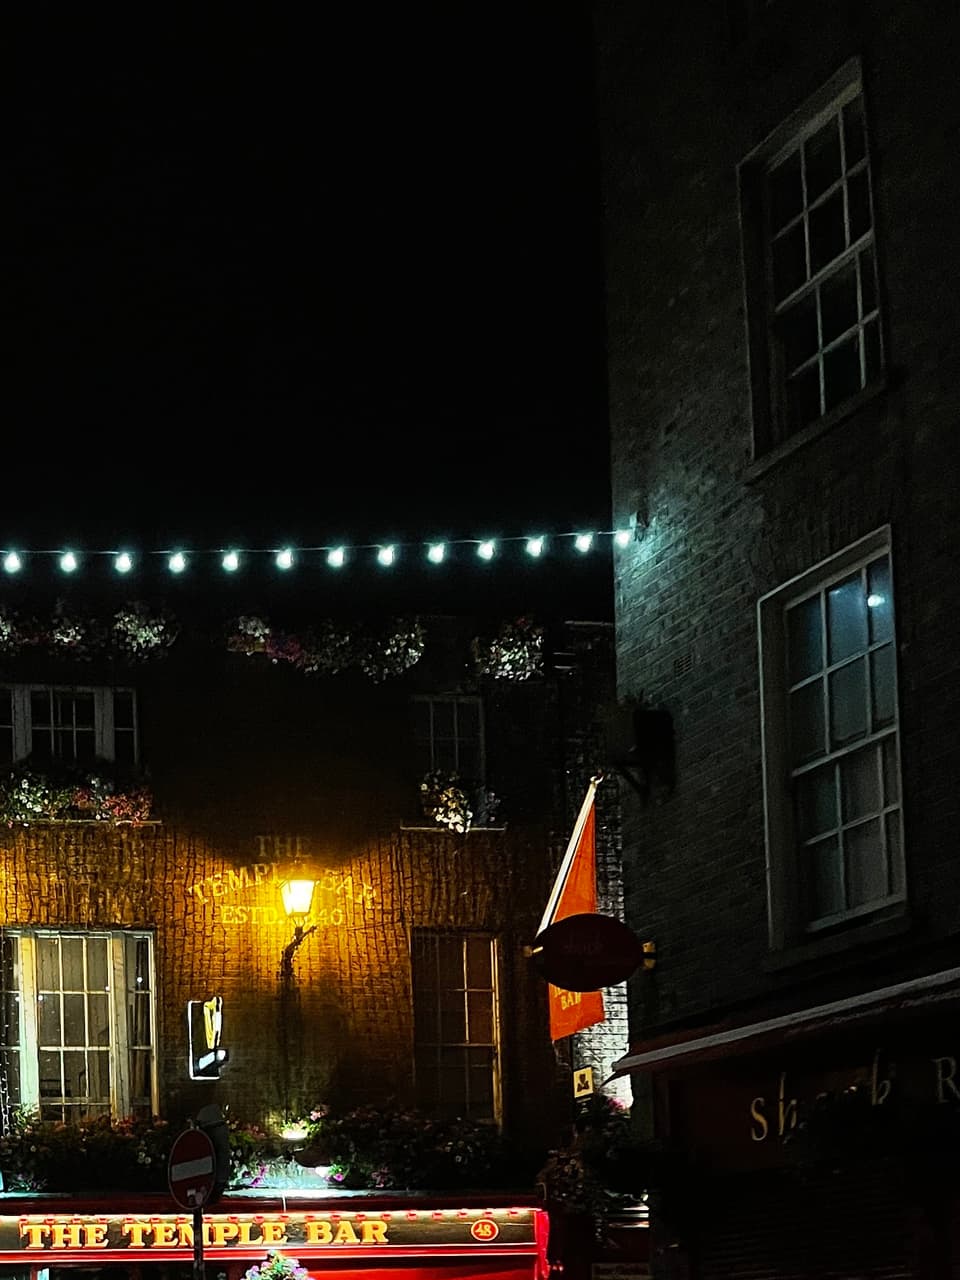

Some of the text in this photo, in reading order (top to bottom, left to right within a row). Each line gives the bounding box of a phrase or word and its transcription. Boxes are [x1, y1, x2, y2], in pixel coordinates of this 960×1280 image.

[20, 1220, 390, 1250] THE TEMPLE BAR
[474, 1223, 492, 1237] 48
